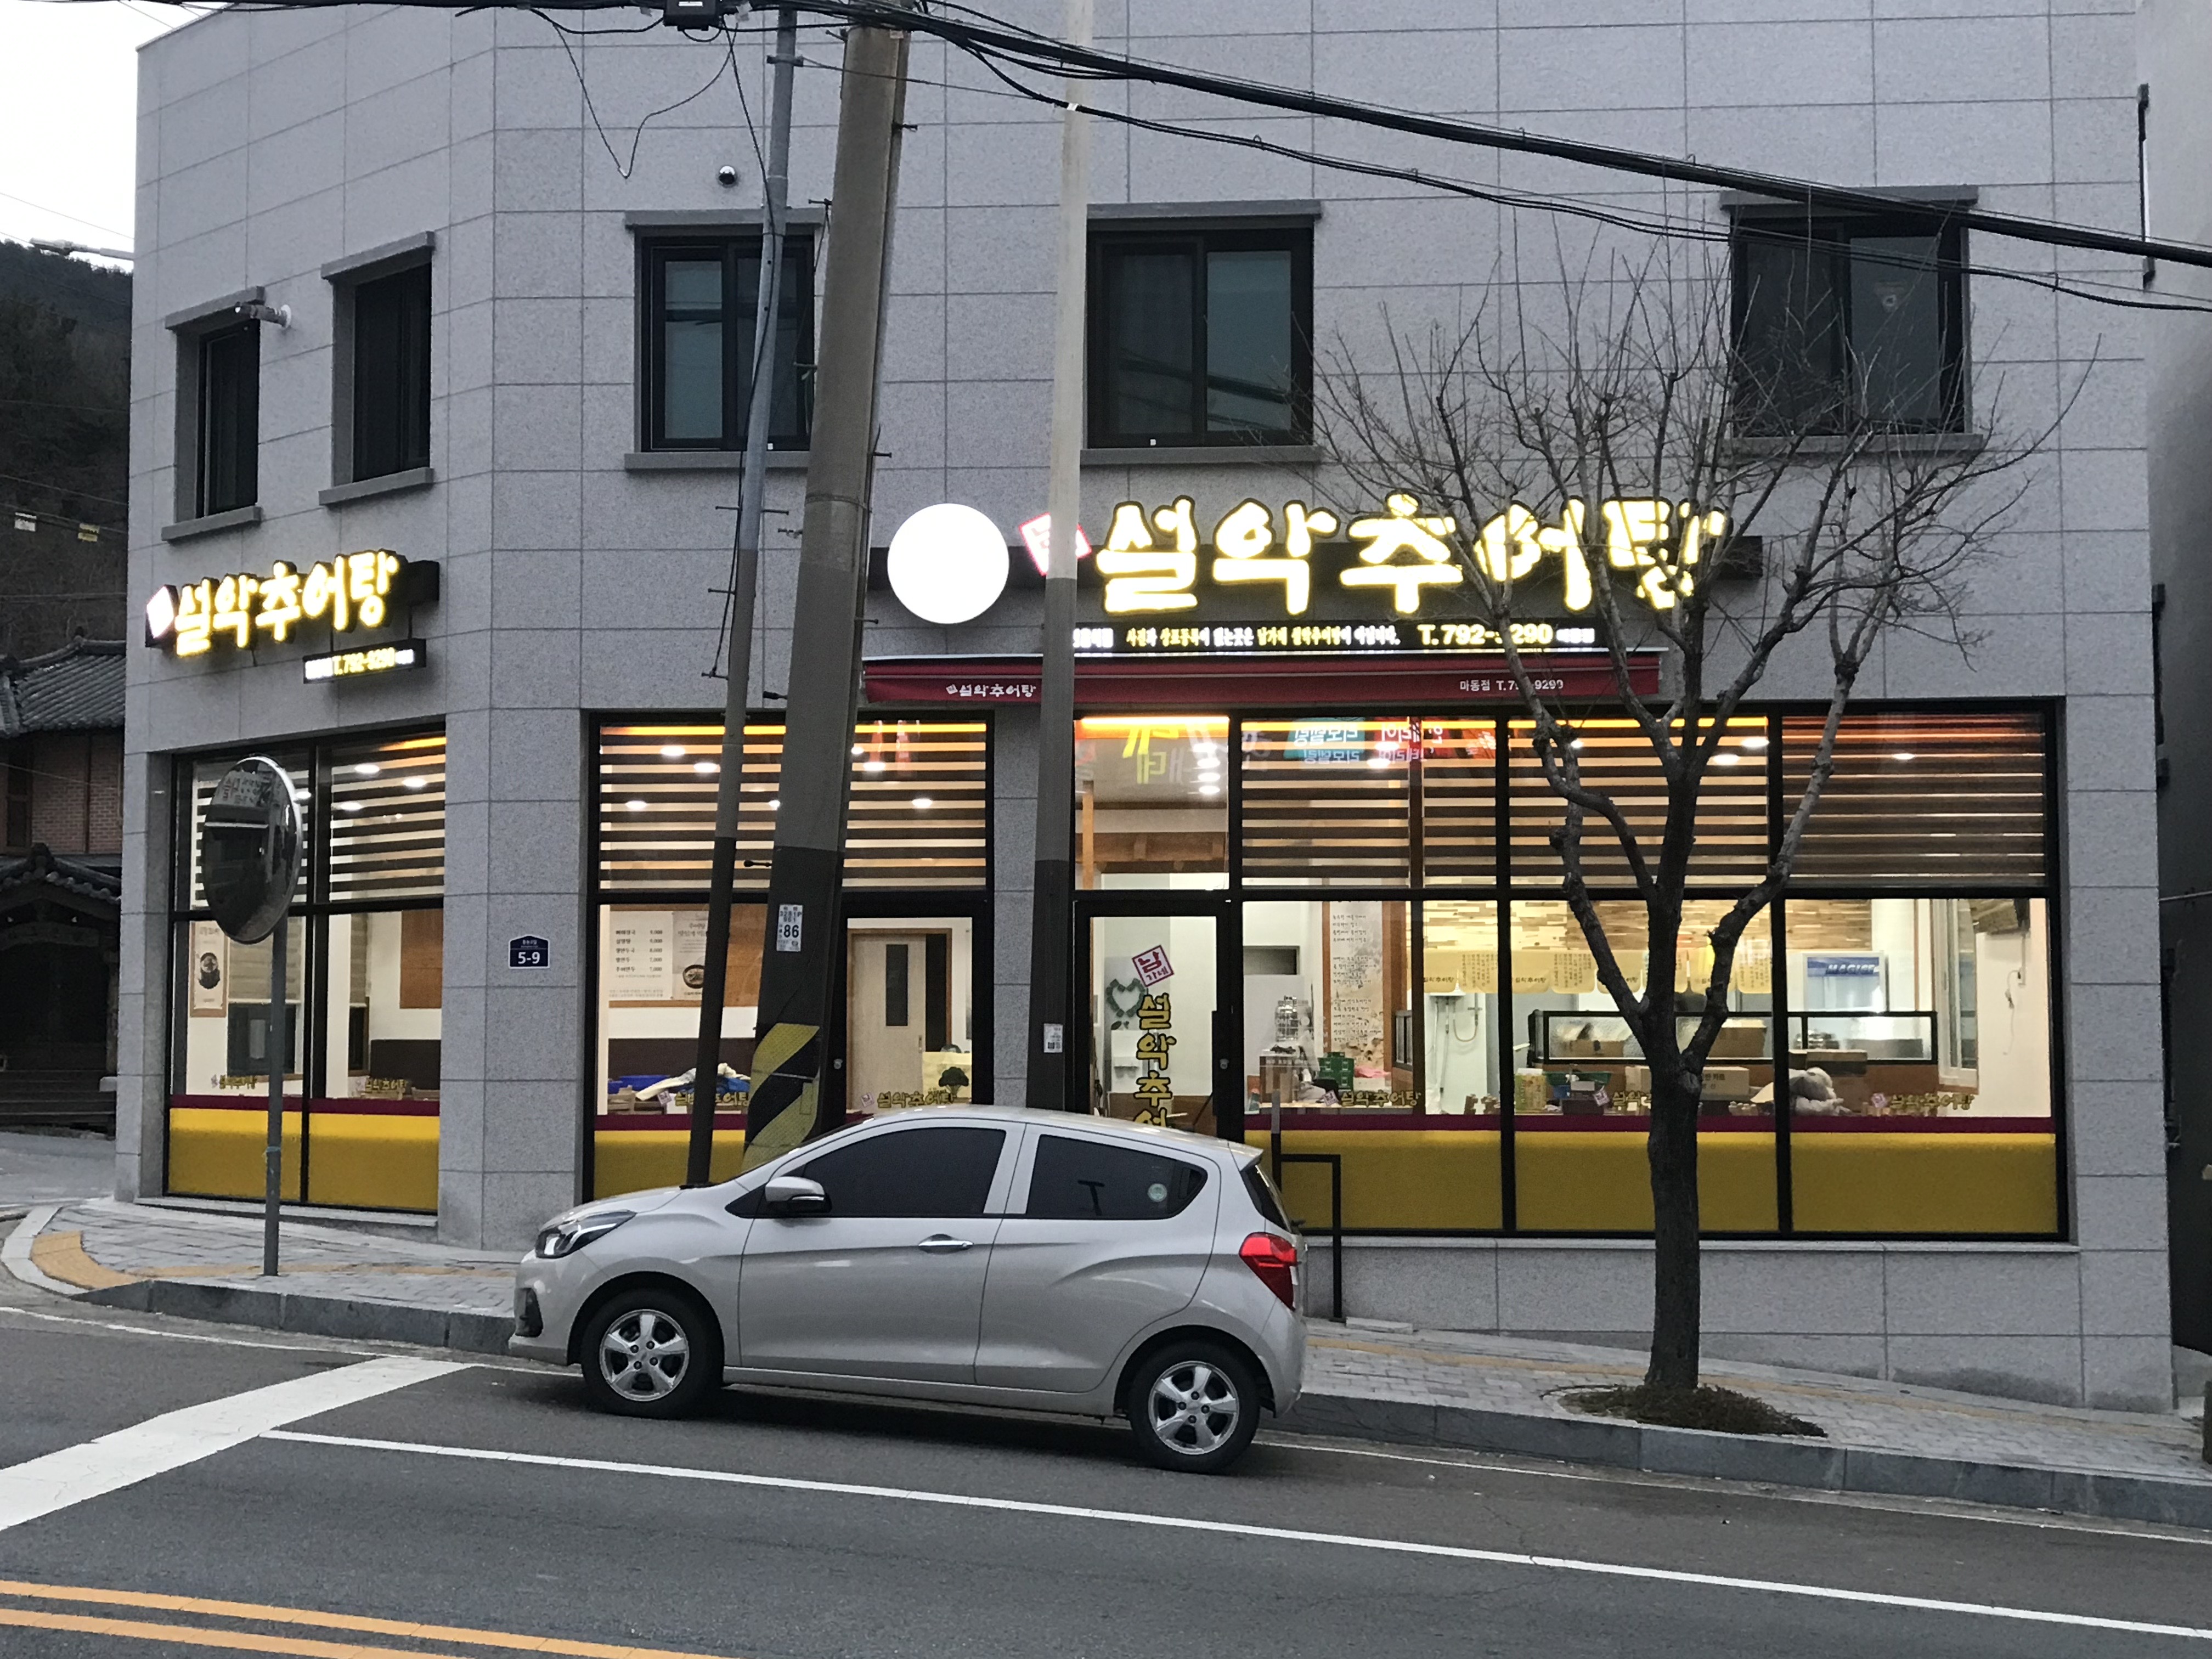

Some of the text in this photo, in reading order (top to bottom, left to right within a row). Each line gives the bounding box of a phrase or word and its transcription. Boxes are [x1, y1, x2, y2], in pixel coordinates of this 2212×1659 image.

[1096, 492, 1728, 616] 설악추어탕
[174, 550, 399, 657] 설악추어탕
[959, 684, 1037, 698] 설악추어탕
[1460, 679, 1491, 691] 마동점
[783, 924, 799, 938] 86
[518, 951, 540, 964] 5-9
[1138, 951, 1162, 974] 남
[1146, 966, 1169, 981] 가네
[1341, 1089, 1422, 1108] 설악추어탕
